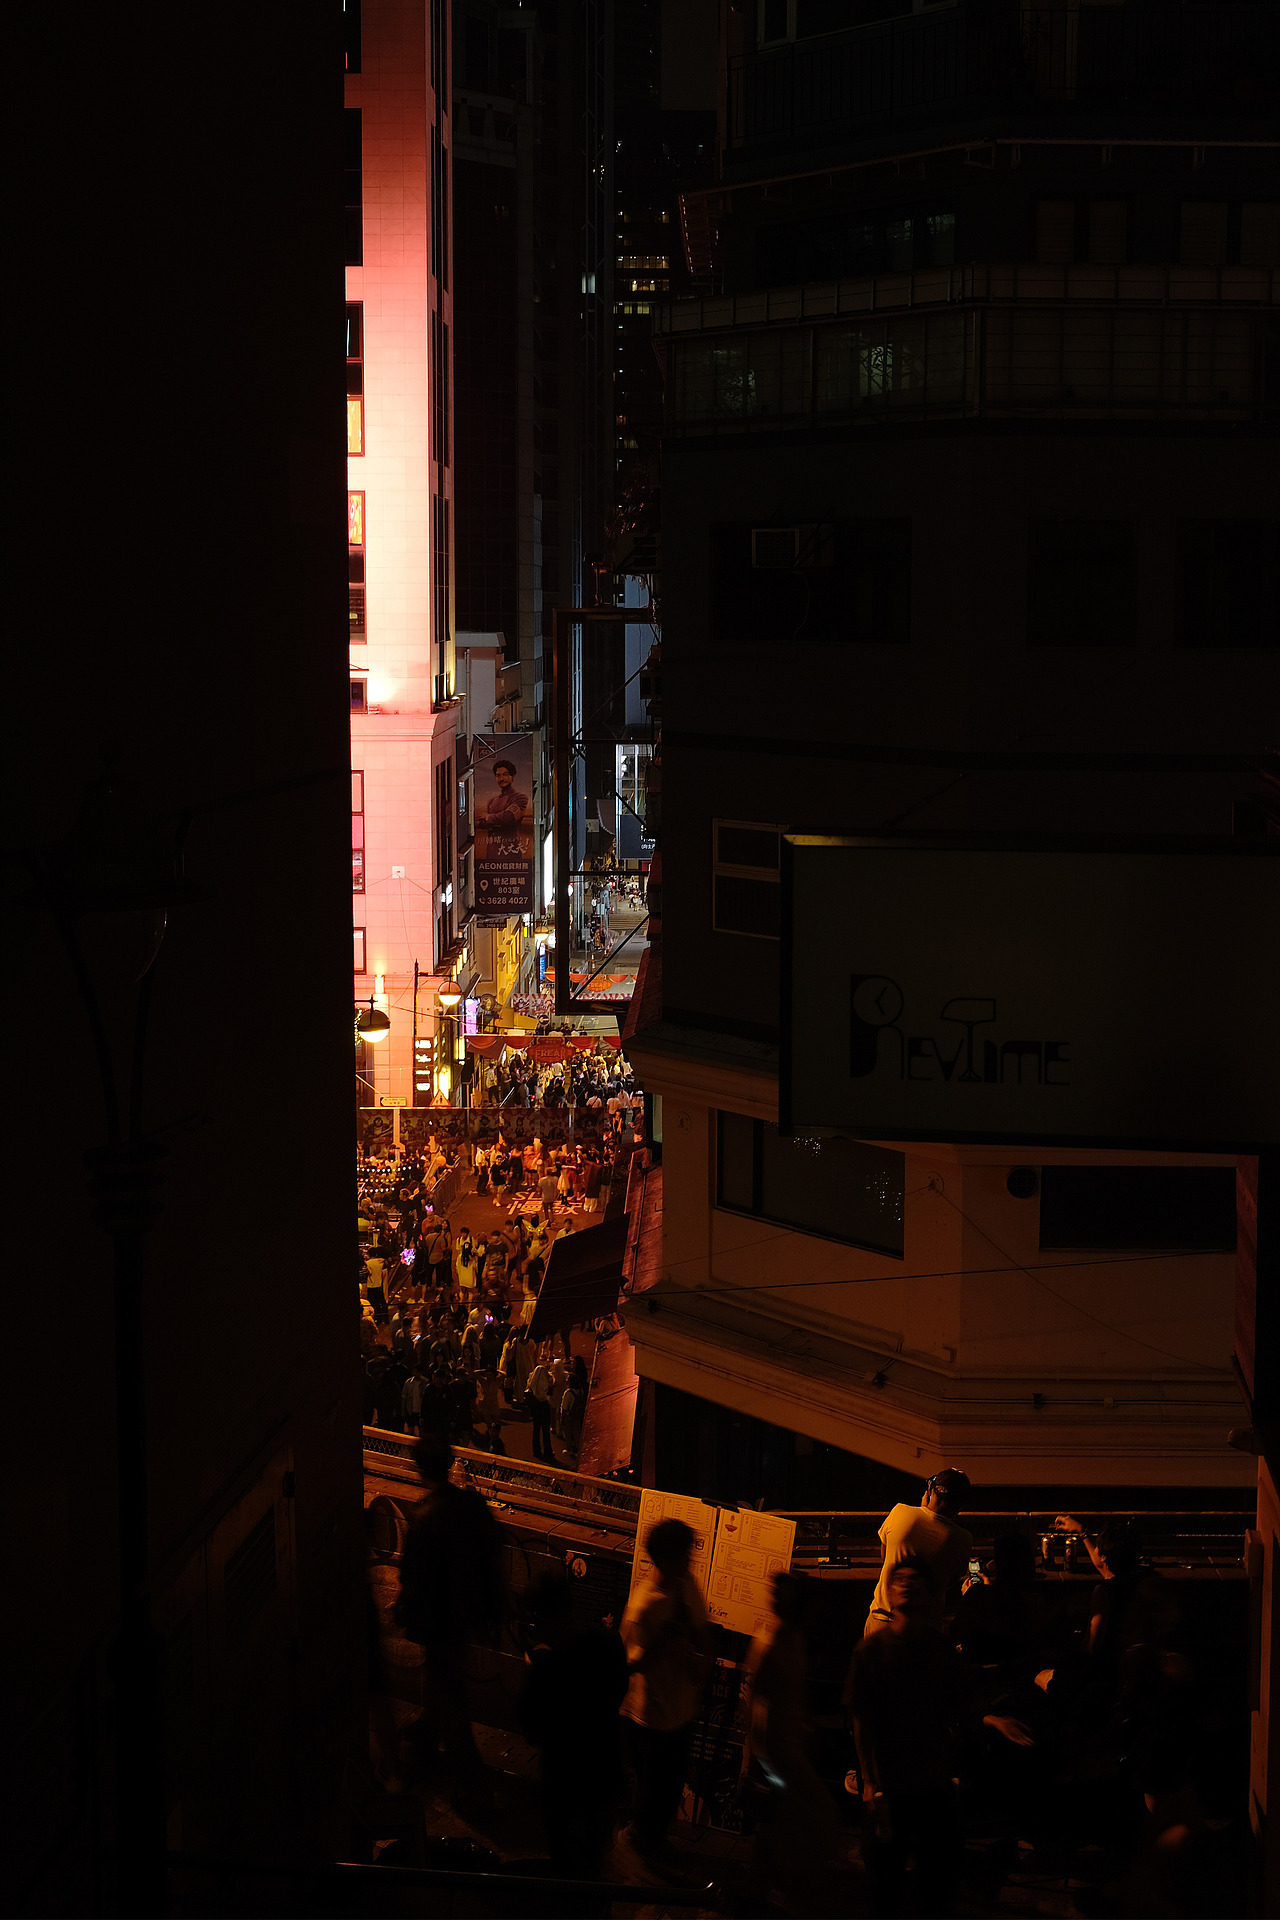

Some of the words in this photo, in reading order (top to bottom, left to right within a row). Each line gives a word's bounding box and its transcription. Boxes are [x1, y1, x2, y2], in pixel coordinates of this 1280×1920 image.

[493, 877, 526, 885] 世紀廣場
[498, 886, 520, 895] 803室
